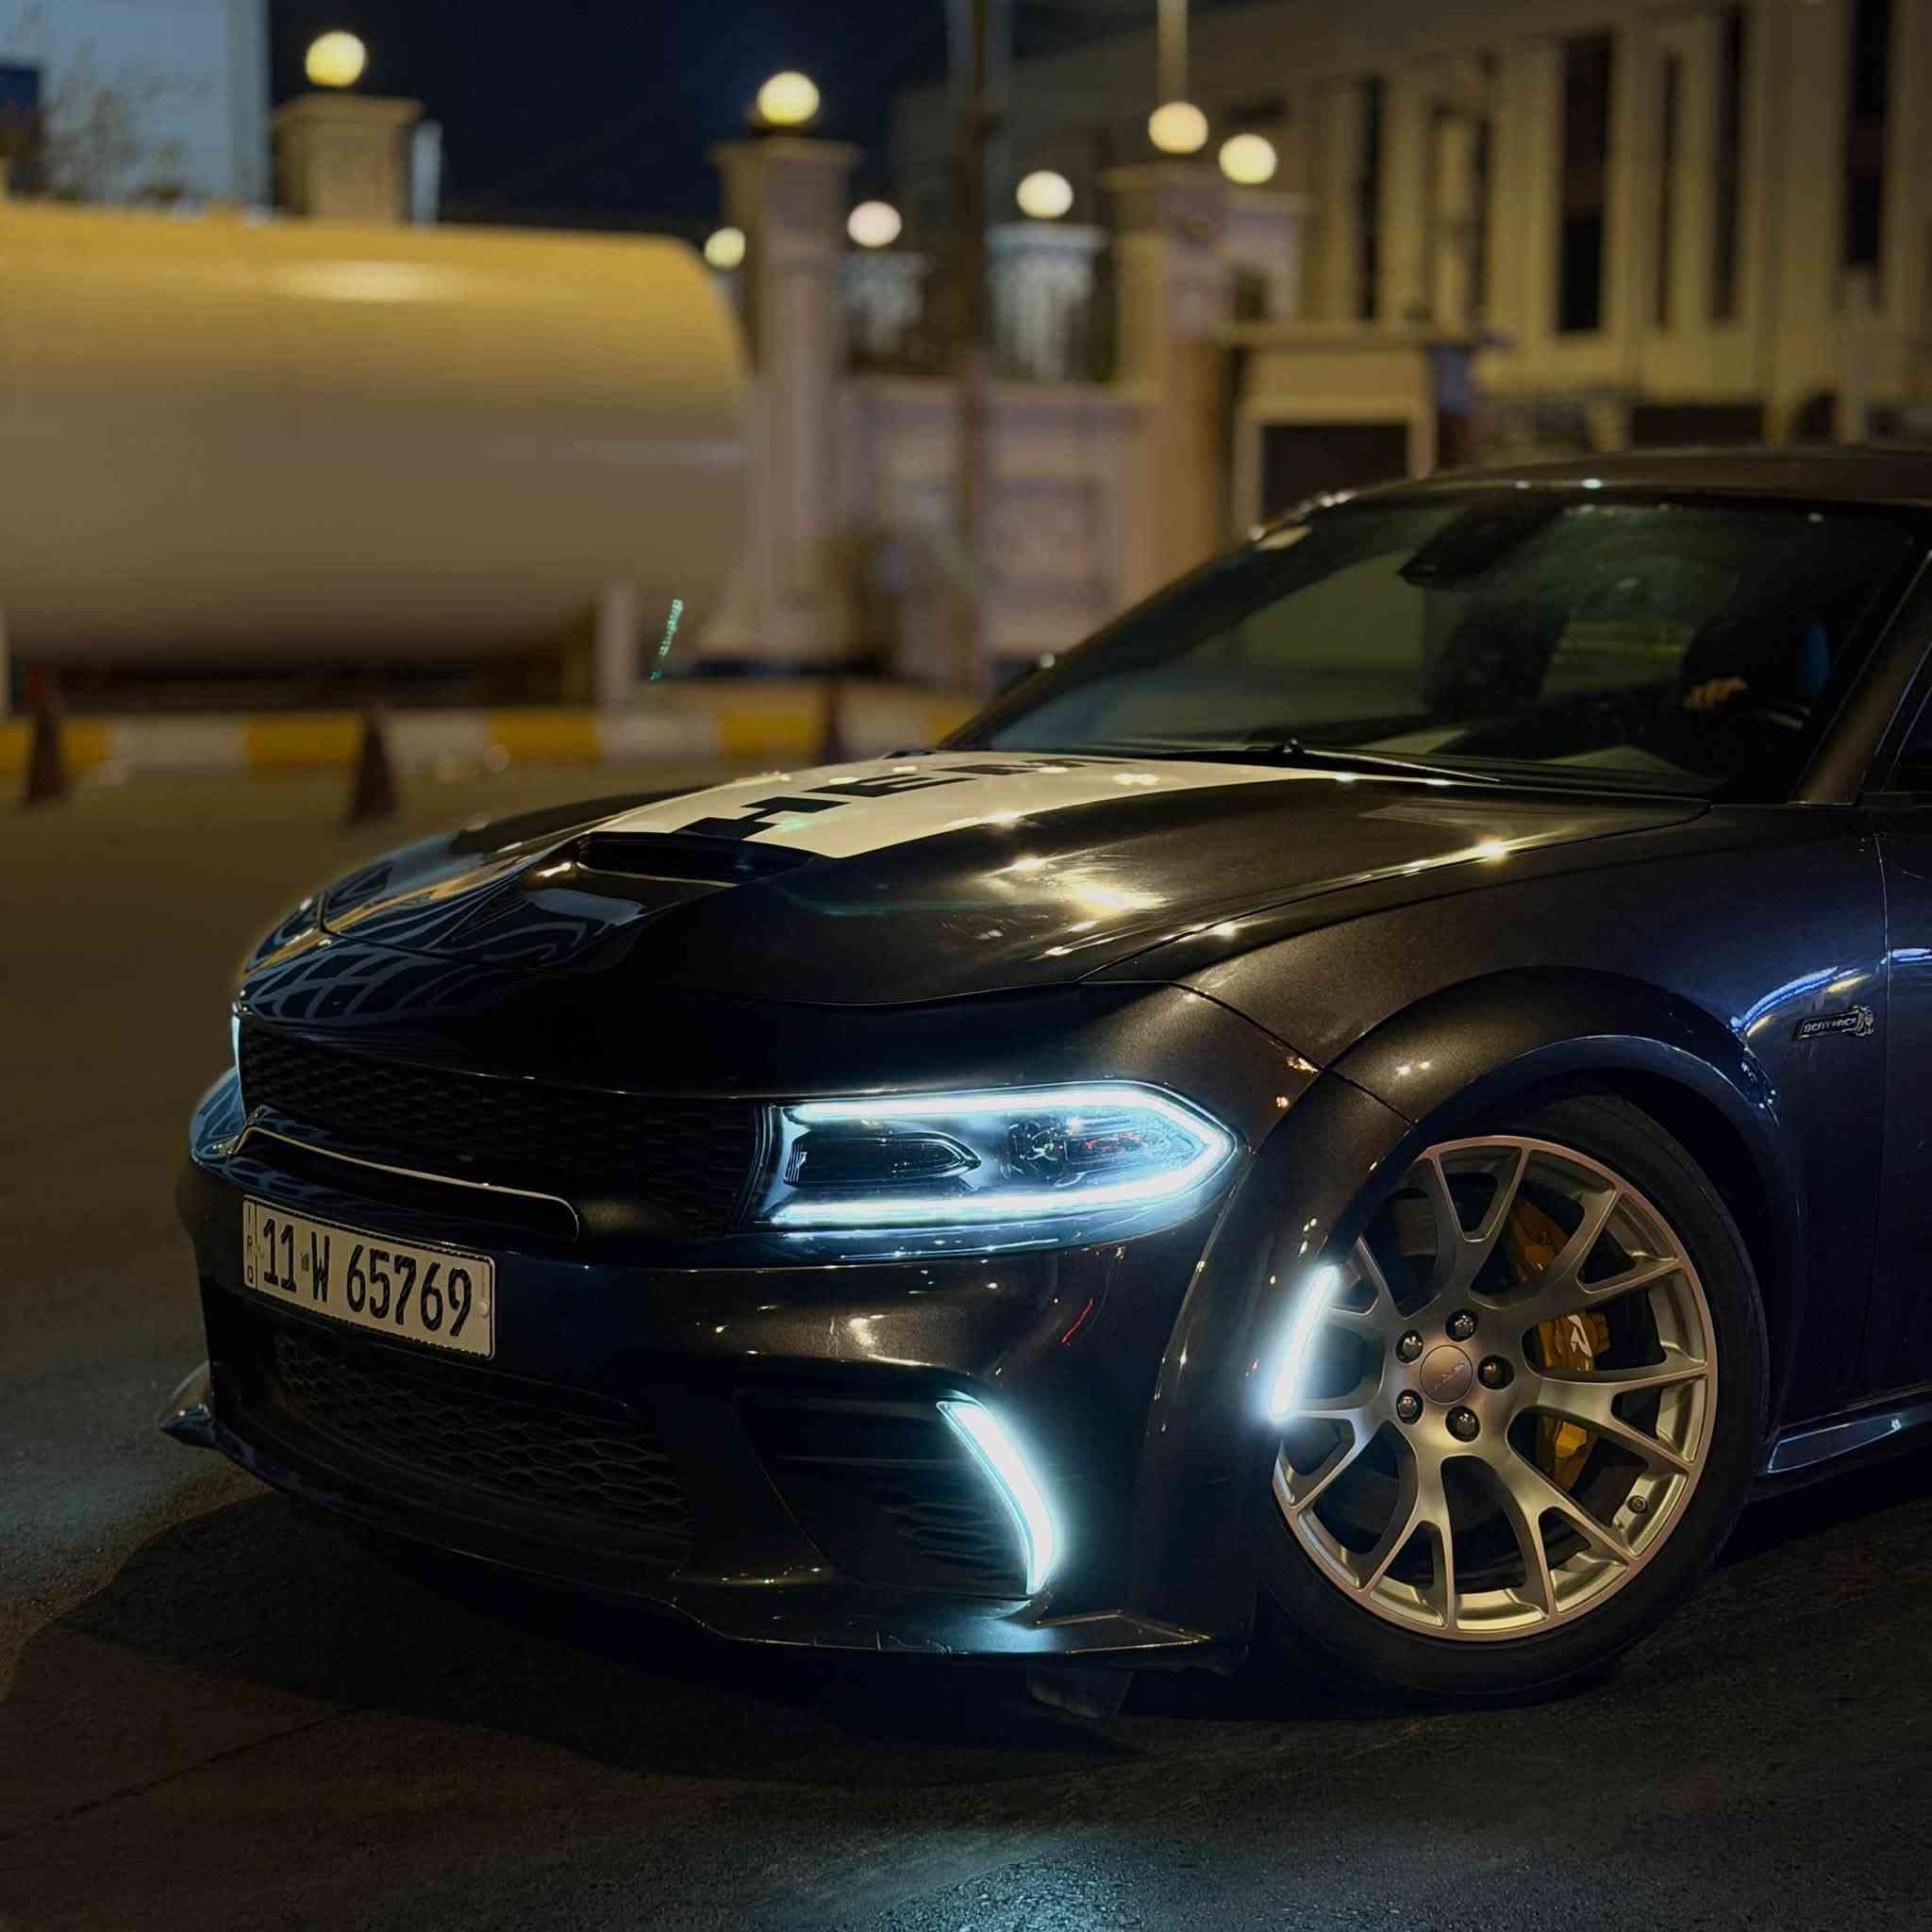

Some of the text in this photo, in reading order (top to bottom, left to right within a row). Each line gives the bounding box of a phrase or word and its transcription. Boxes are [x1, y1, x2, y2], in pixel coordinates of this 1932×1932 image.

[263, 1218, 473, 1338] 11 W 65769
